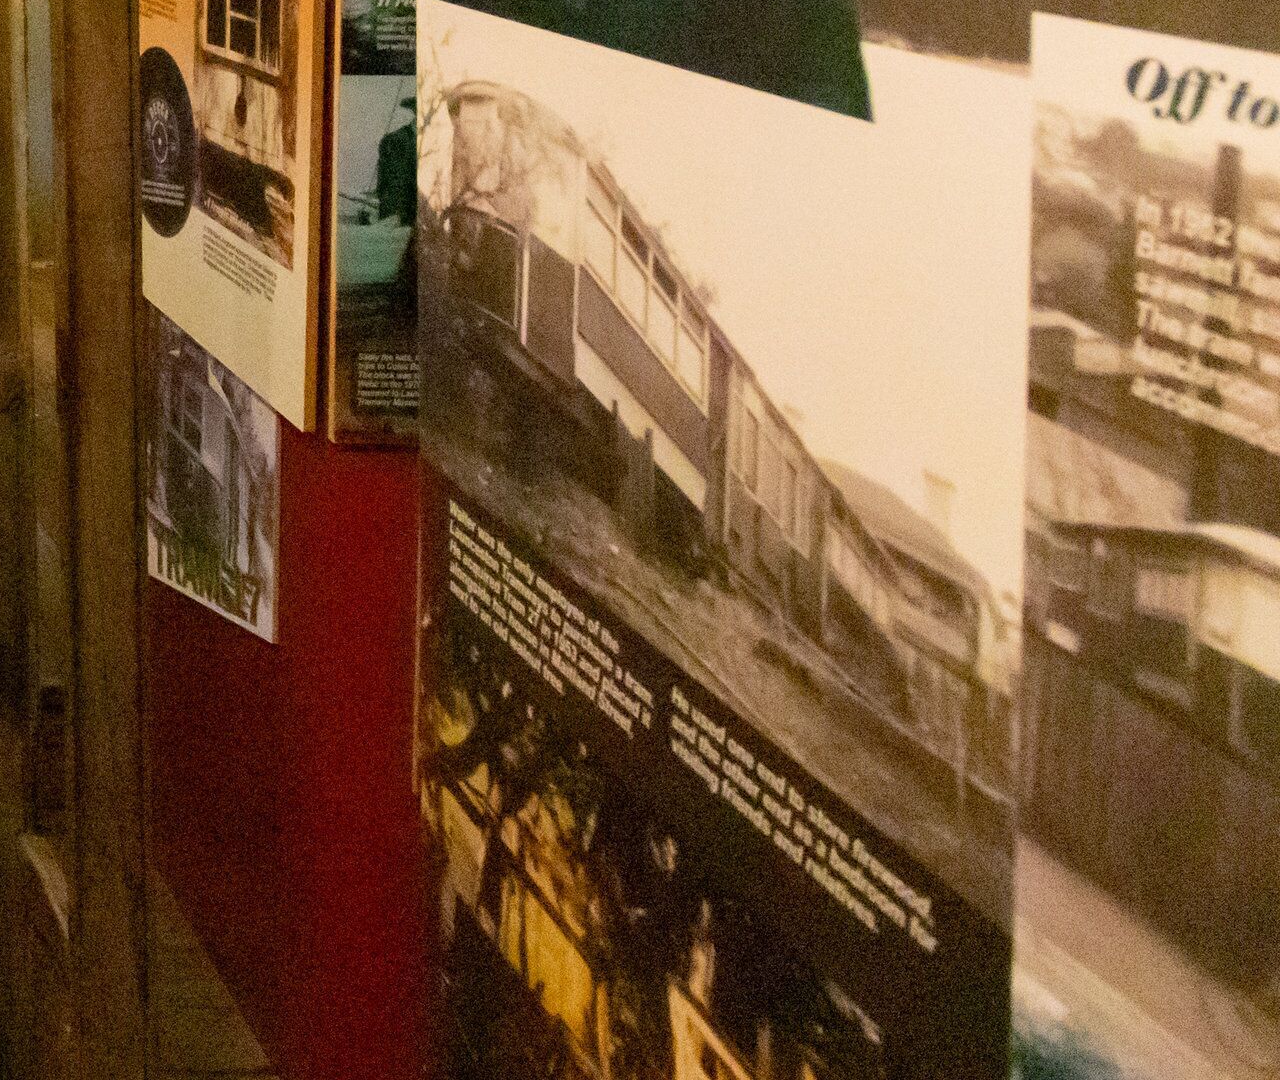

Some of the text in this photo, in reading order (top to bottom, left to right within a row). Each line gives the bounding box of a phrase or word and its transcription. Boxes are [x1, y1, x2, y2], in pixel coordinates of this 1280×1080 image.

[1126, 56, 1280, 130] Off to
[450, 518, 499, 572] Launceston
[502, 563, 548, 617] Tramways
[562, 620, 613, 671] purchase
[502, 583, 525, 617] Tram
